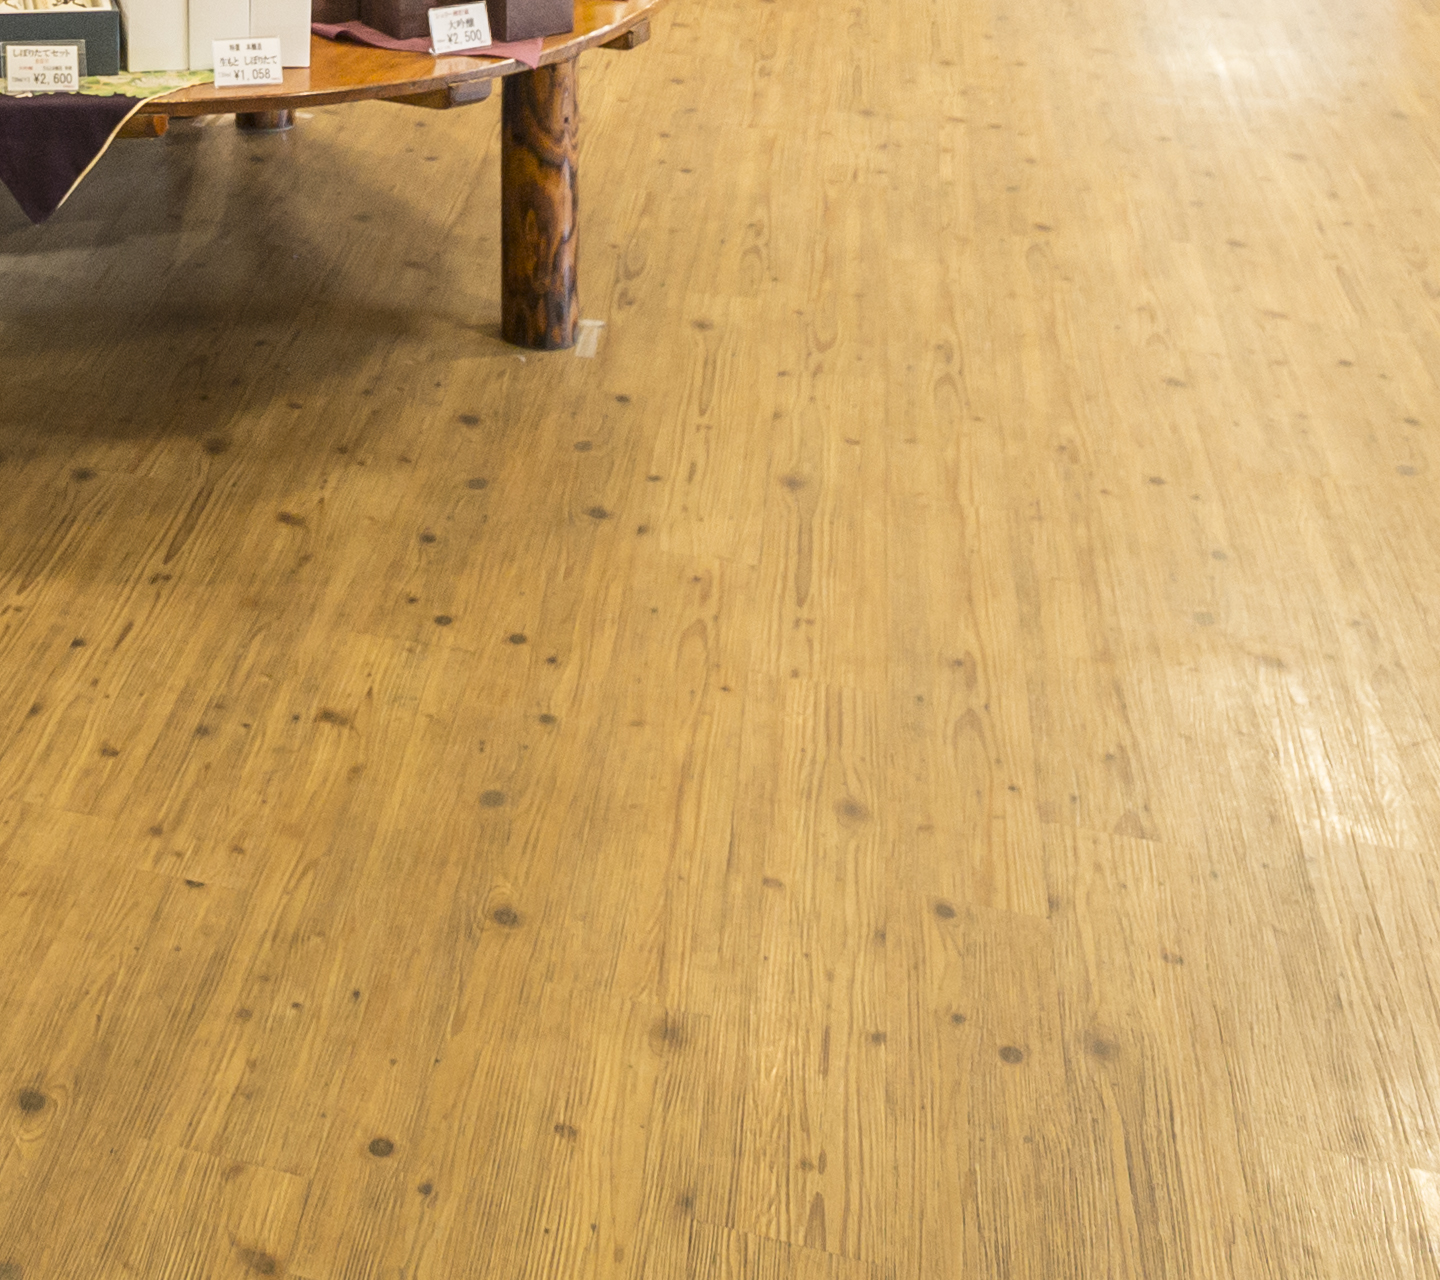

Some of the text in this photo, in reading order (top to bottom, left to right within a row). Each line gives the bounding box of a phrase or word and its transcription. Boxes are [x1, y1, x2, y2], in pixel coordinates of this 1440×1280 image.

[13, 48, 71, 58] しぼりたてセット
[244, 55, 278, 65] しぼりたて
